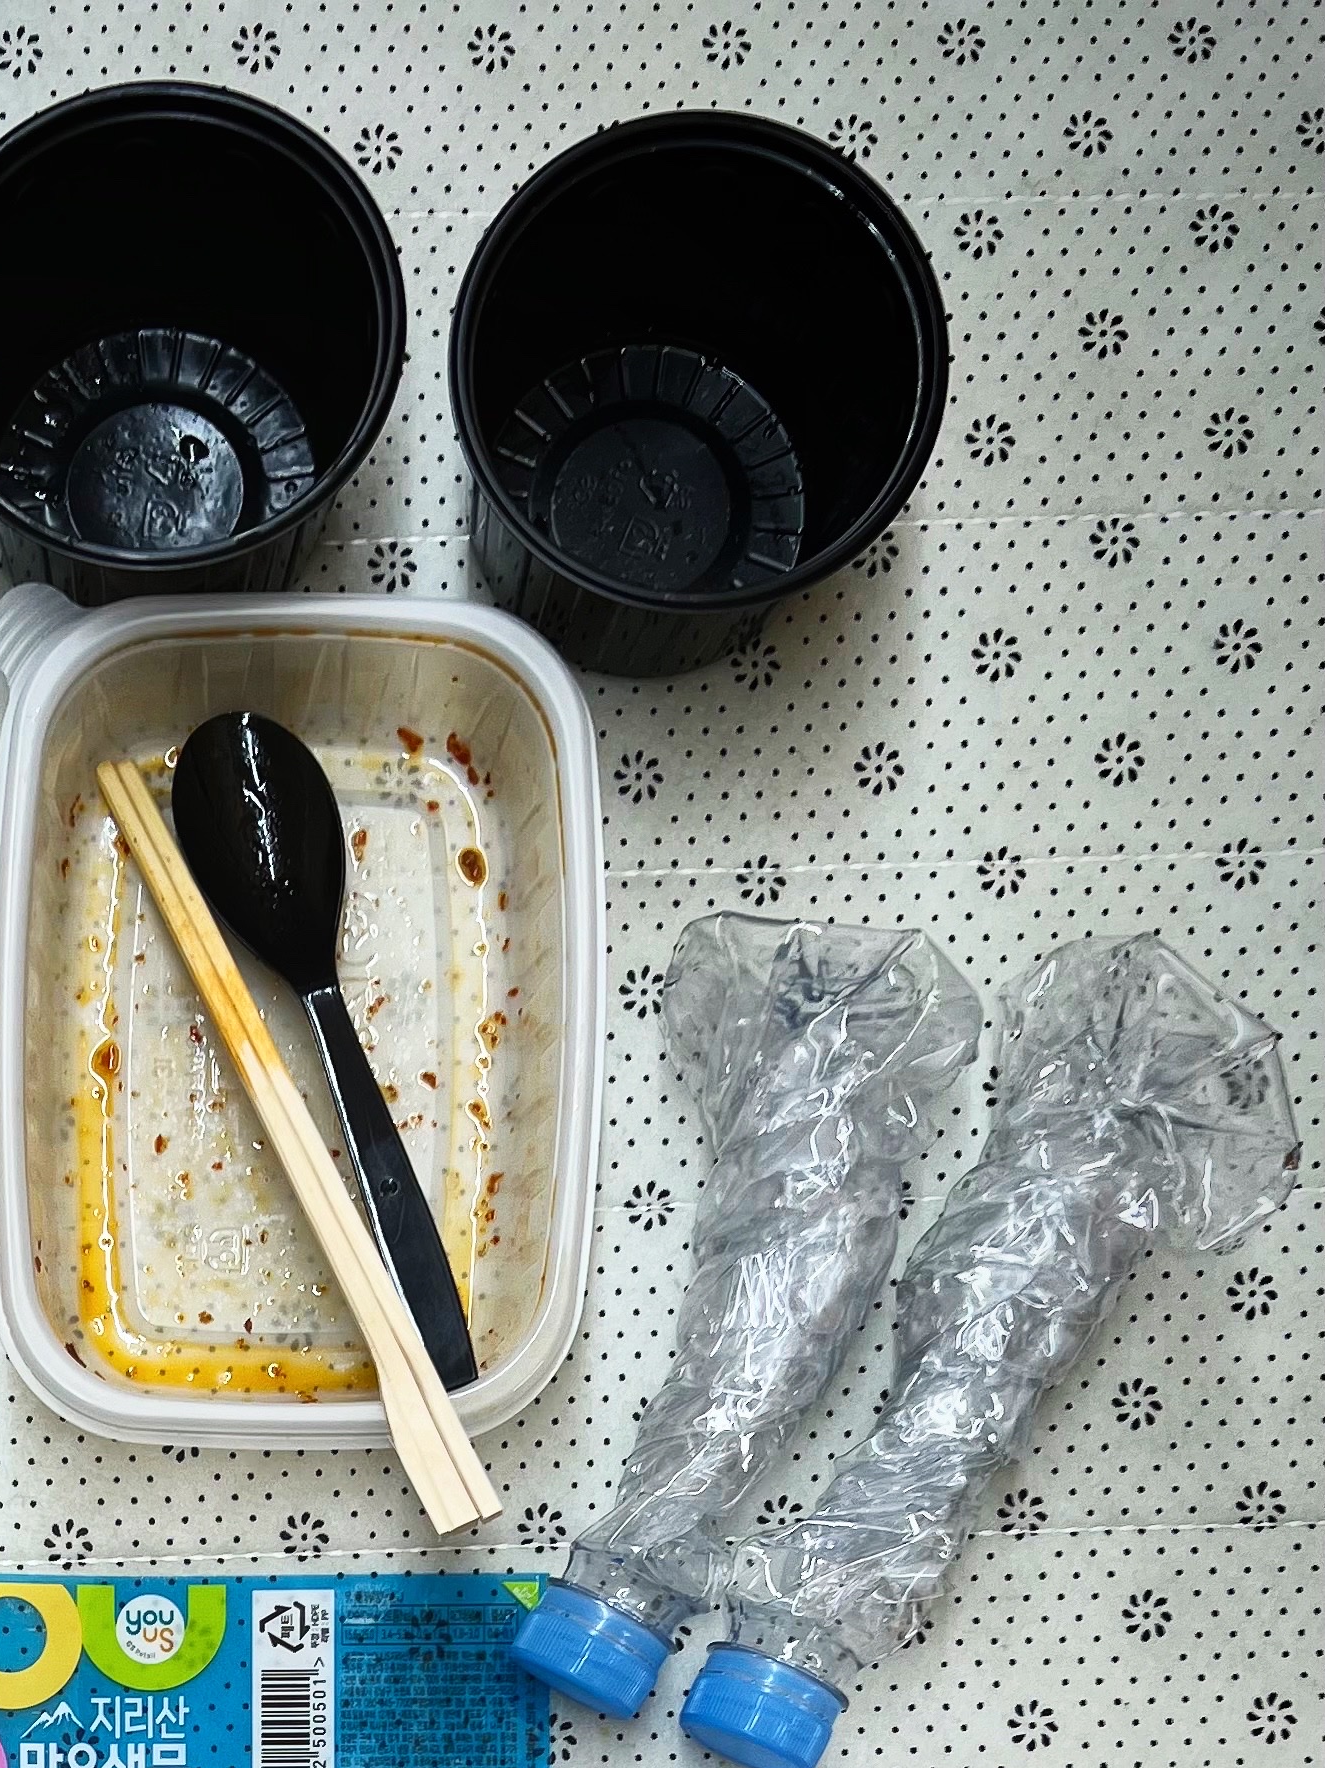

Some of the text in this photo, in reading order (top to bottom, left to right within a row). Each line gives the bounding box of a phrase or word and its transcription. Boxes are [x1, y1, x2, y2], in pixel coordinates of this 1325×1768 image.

[126, 1610, 174, 1636] you
[142, 1627, 174, 1653] us
[89, 1695, 190, 1742] 지리산
[312, 1678, 328, 1749] 500501
